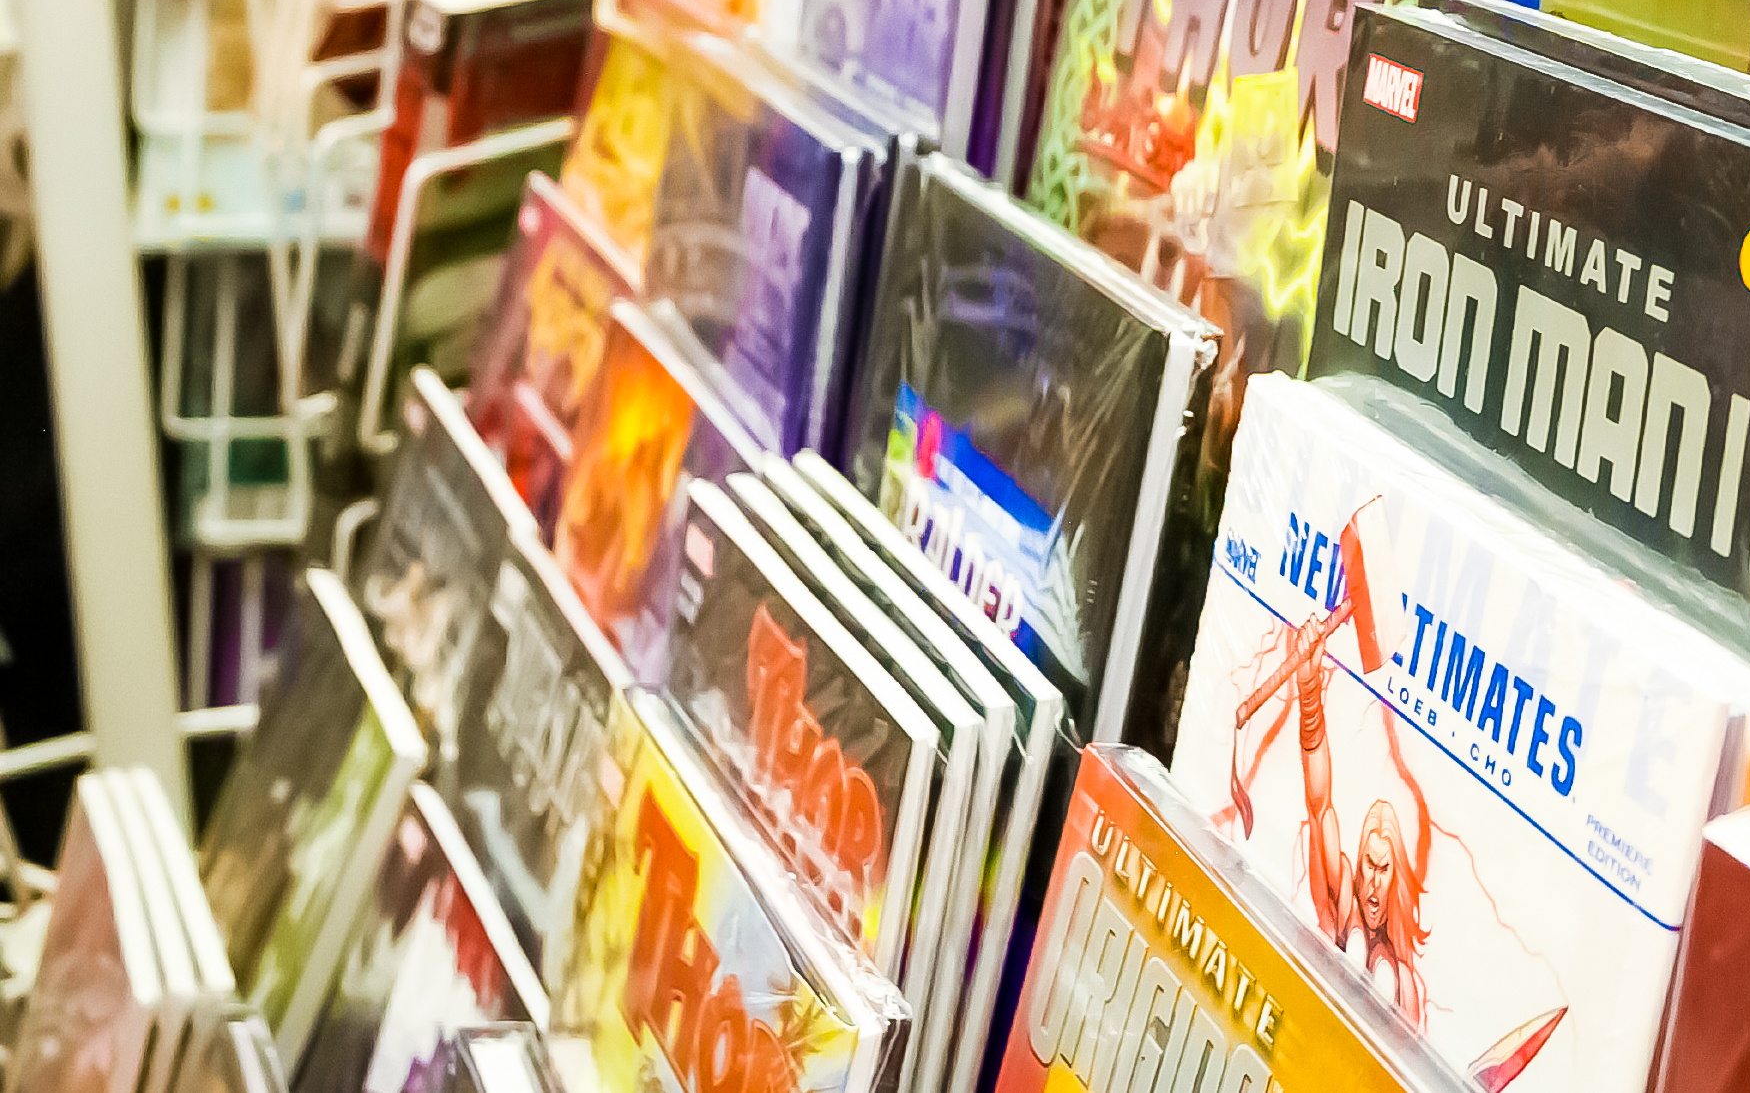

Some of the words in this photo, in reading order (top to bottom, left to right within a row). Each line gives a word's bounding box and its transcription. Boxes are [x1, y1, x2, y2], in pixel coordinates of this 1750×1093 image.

[1364, 56, 1422, 121] MARVEL
[1447, 174, 1676, 322] ULTIMATE
[1333, 199, 1498, 415] IRON
[1500, 284, 1712, 540] MAN
[1387, 676, 1438, 727] LOEB
[1470, 742, 1513, 788] CHO
[1391, 593, 1584, 798] TIMATES
[1091, 809, 1284, 1047] ULTIMATE
[1587, 840, 1642, 892] EDITION
